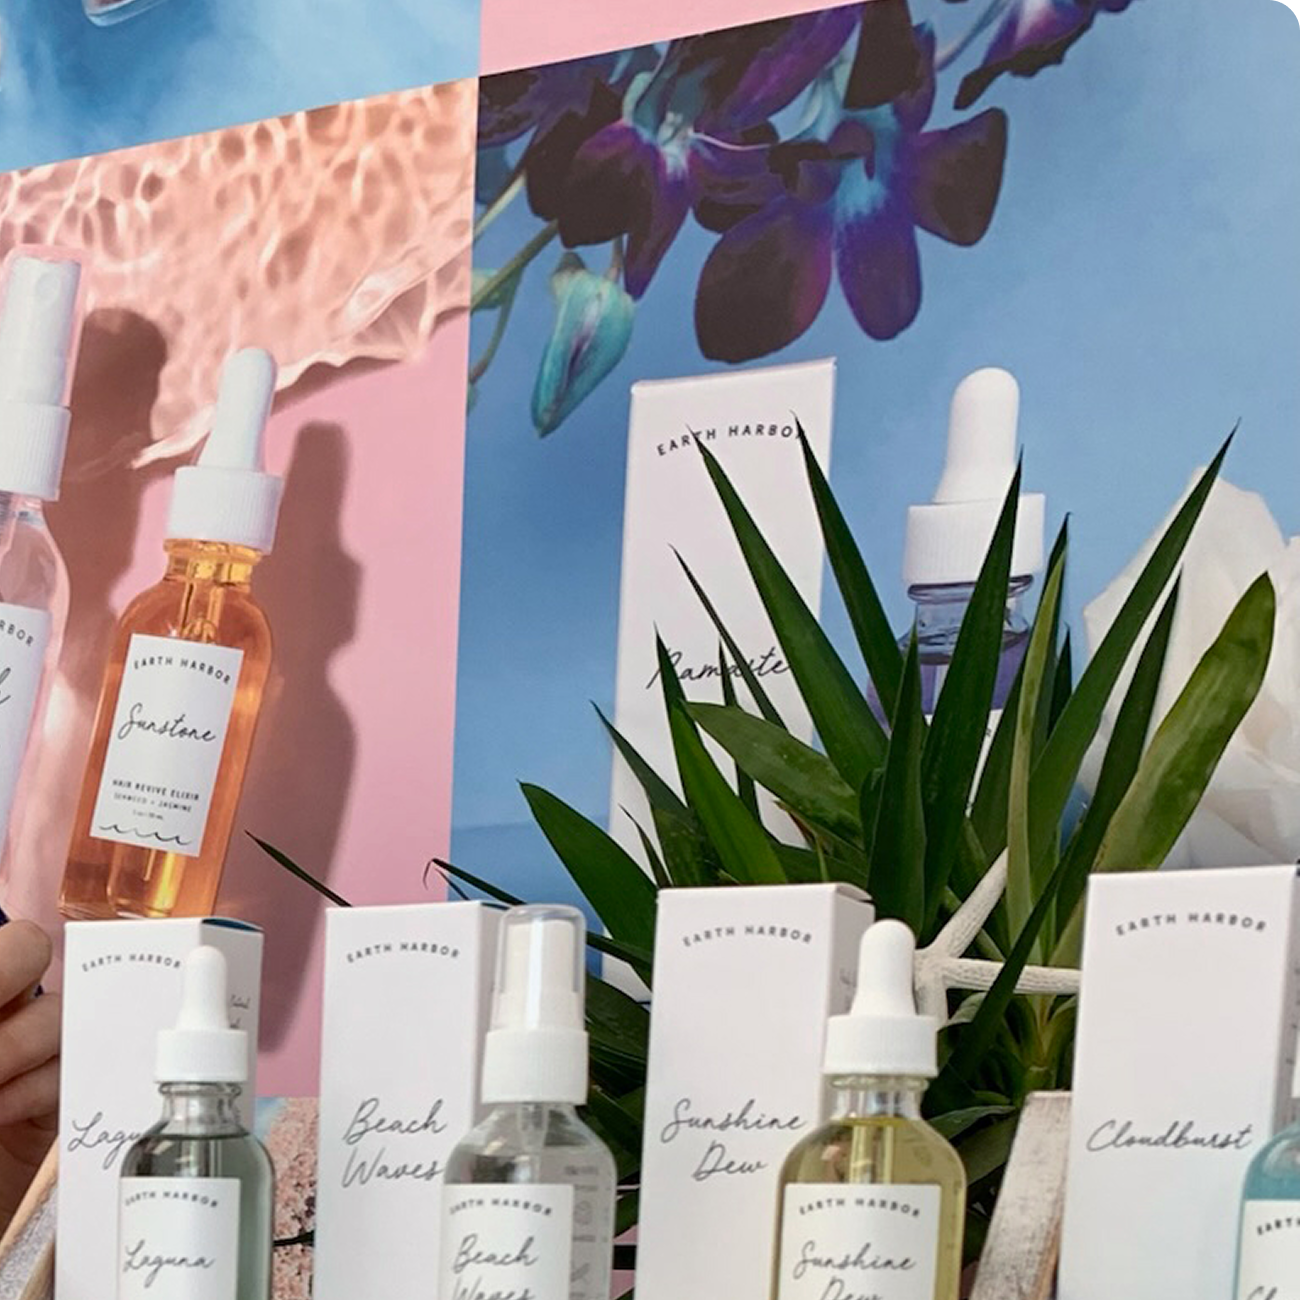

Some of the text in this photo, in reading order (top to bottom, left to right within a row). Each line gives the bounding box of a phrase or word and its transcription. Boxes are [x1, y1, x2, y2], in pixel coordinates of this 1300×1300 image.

[657, 428, 717, 456] EARTH
[134, 656, 232, 686] EARTH HARBOR
[116, 702, 217, 743] Sunstone
[112, 779, 200, 801] HAIR REVIVE ELIXIR
[683, 924, 813, 948] EARTH HARBOR
[1114, 911, 1266, 937] EARTH HARBOR
[81, 952, 182, 973] EARTH HARBOR
[347, 941, 461, 964] EARTH HARBOR
[342, 1097, 448, 1147] Beach
[660, 1097, 806, 1145] Sunshine
[1085, 1119, 1255, 1152] Cloudburst
[341, 1147, 445, 1190] Waves
[690, 1137, 770, 1183] Dew
[163, 1190, 218, 1208] HARBOR
[491, 1197, 553, 1217] HARBOR
[799, 1197, 921, 1219] EARTH HARBOR
[123, 1238, 218, 1289] Laguna
[452, 1232, 539, 1275] Beach
[792, 1238, 917, 1282] Sunshine
